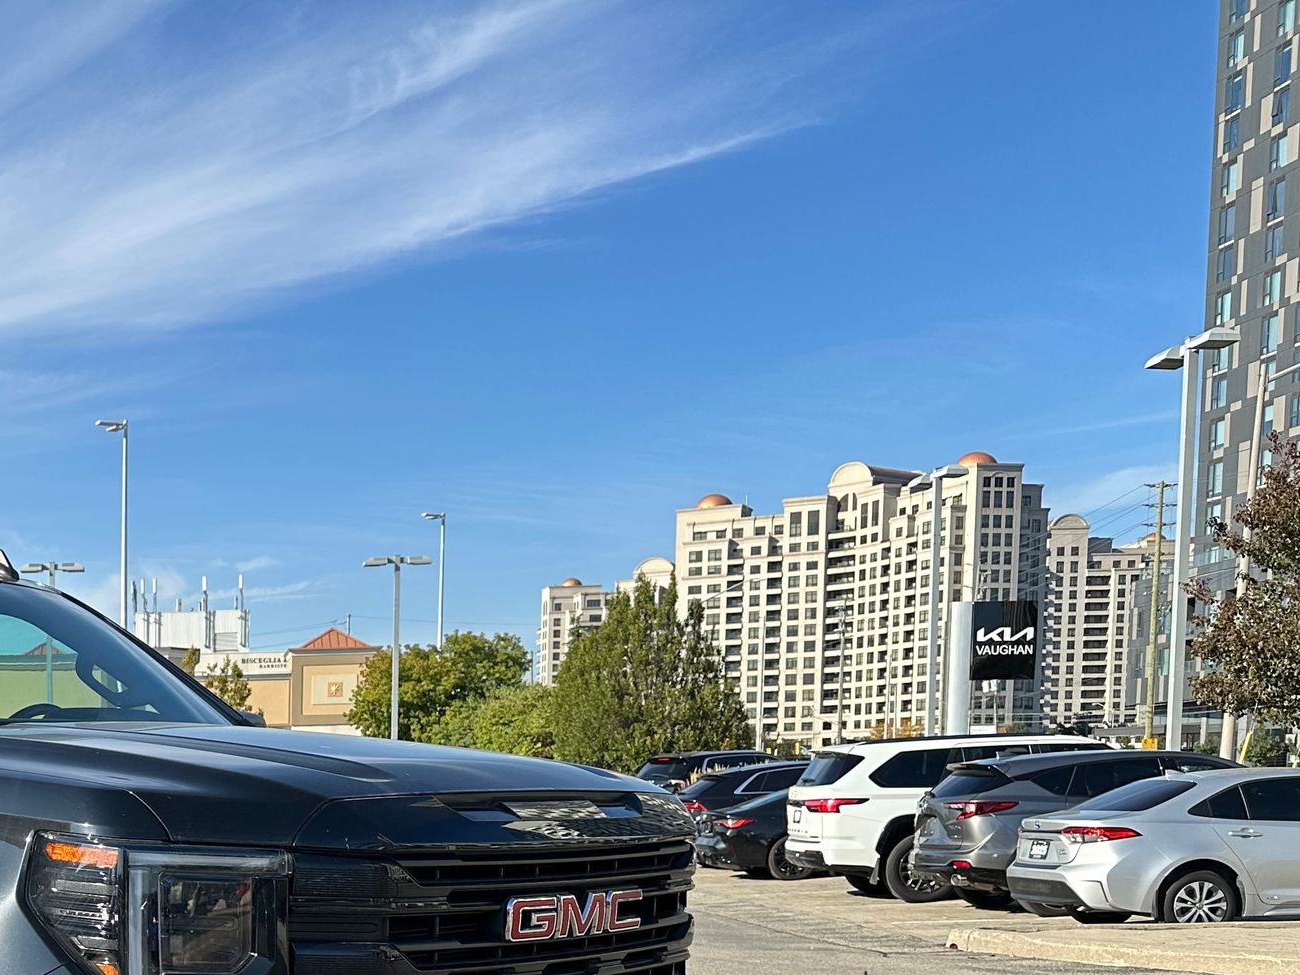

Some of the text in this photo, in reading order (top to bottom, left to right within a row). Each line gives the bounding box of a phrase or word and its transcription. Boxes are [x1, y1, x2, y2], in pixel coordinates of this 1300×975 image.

[977, 627, 1034, 641] KIA
[976, 645, 1033, 655] VAUGHAN
[506, 889, 643, 942] GMC
